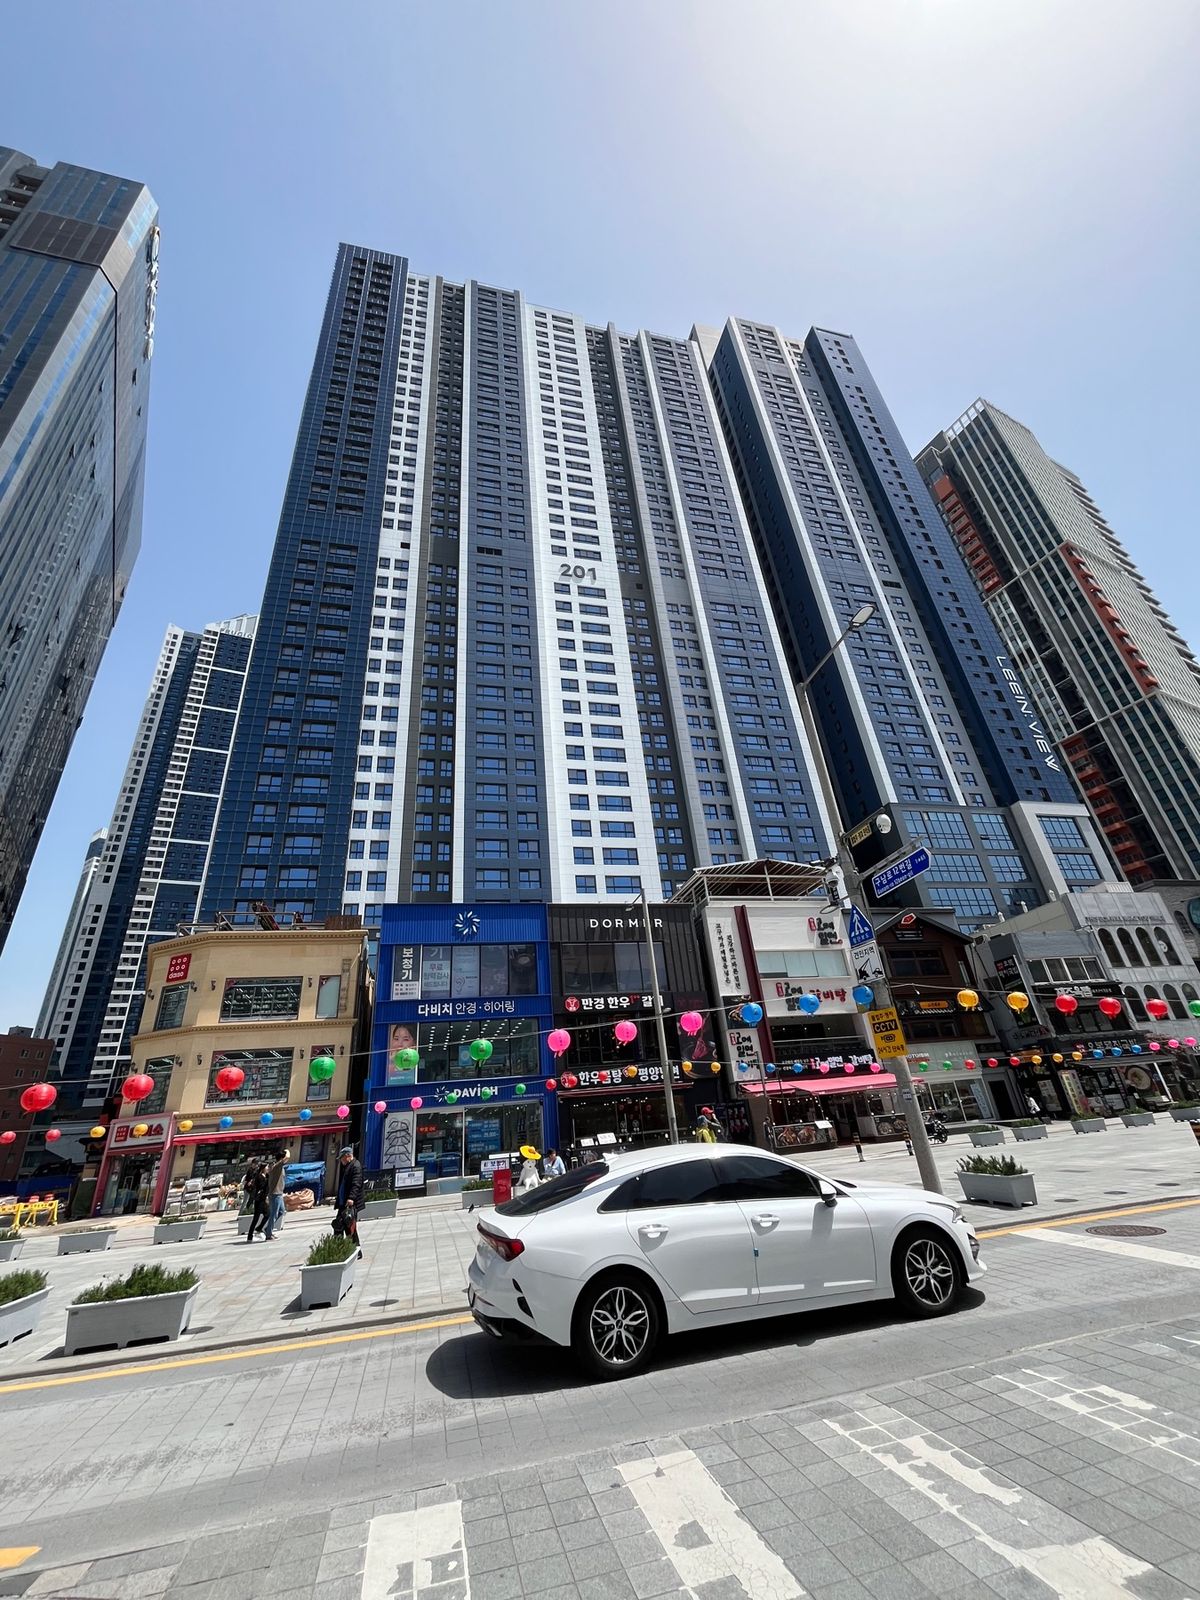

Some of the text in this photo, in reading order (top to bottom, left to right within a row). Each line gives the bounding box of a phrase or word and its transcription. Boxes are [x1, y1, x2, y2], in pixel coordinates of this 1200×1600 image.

[560, 563, 597, 581] 201
[853, 945, 876, 960] 견인지역
[401, 947, 413, 980] 보청기
[418, 1003, 453, 1017] 다비치
[581, 997, 605, 1010] 만경
[607, 996, 630, 1009] 한우
[874, 1020, 896, 1033] CCTV
